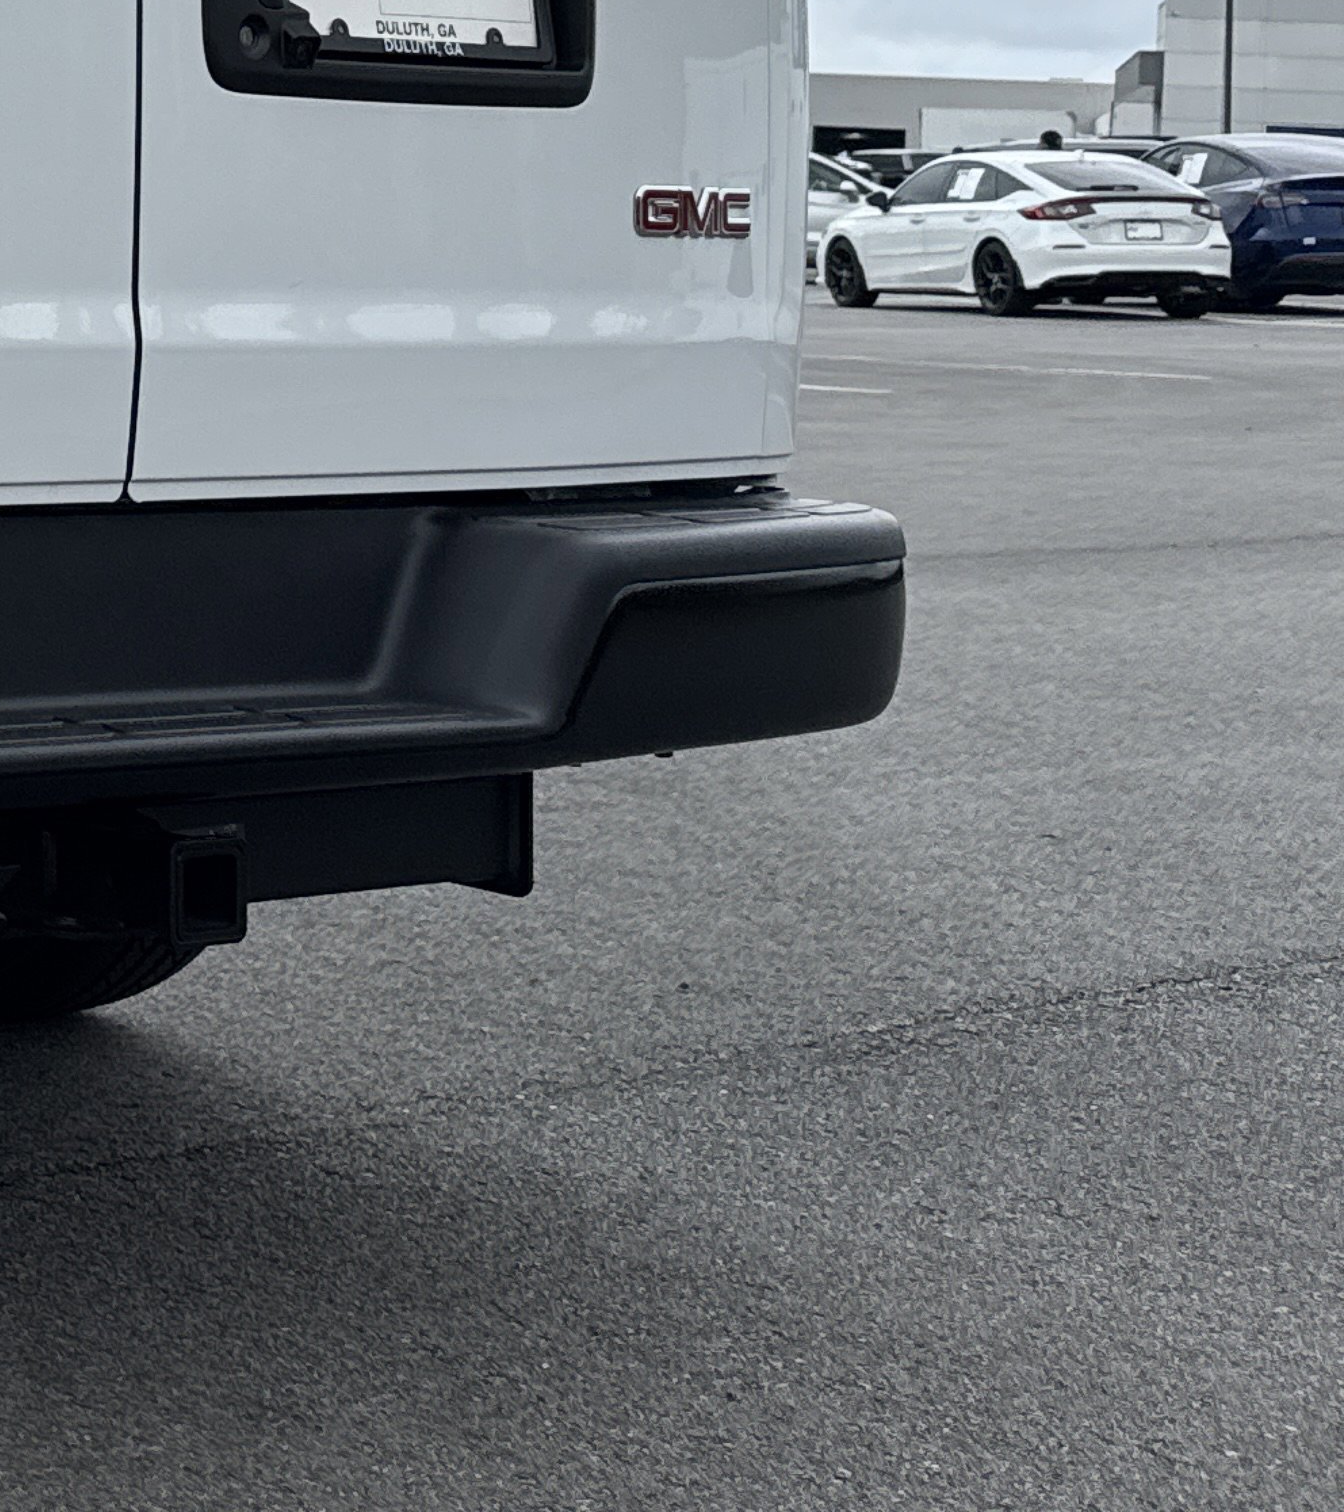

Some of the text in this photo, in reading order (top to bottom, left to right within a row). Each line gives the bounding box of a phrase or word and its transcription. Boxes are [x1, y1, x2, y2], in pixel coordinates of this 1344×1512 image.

[376, 20, 457, 38] DULUTH, GA
[383, 38, 464, 57] DULUTH, GA
[633, 184, 752, 239] GMC
